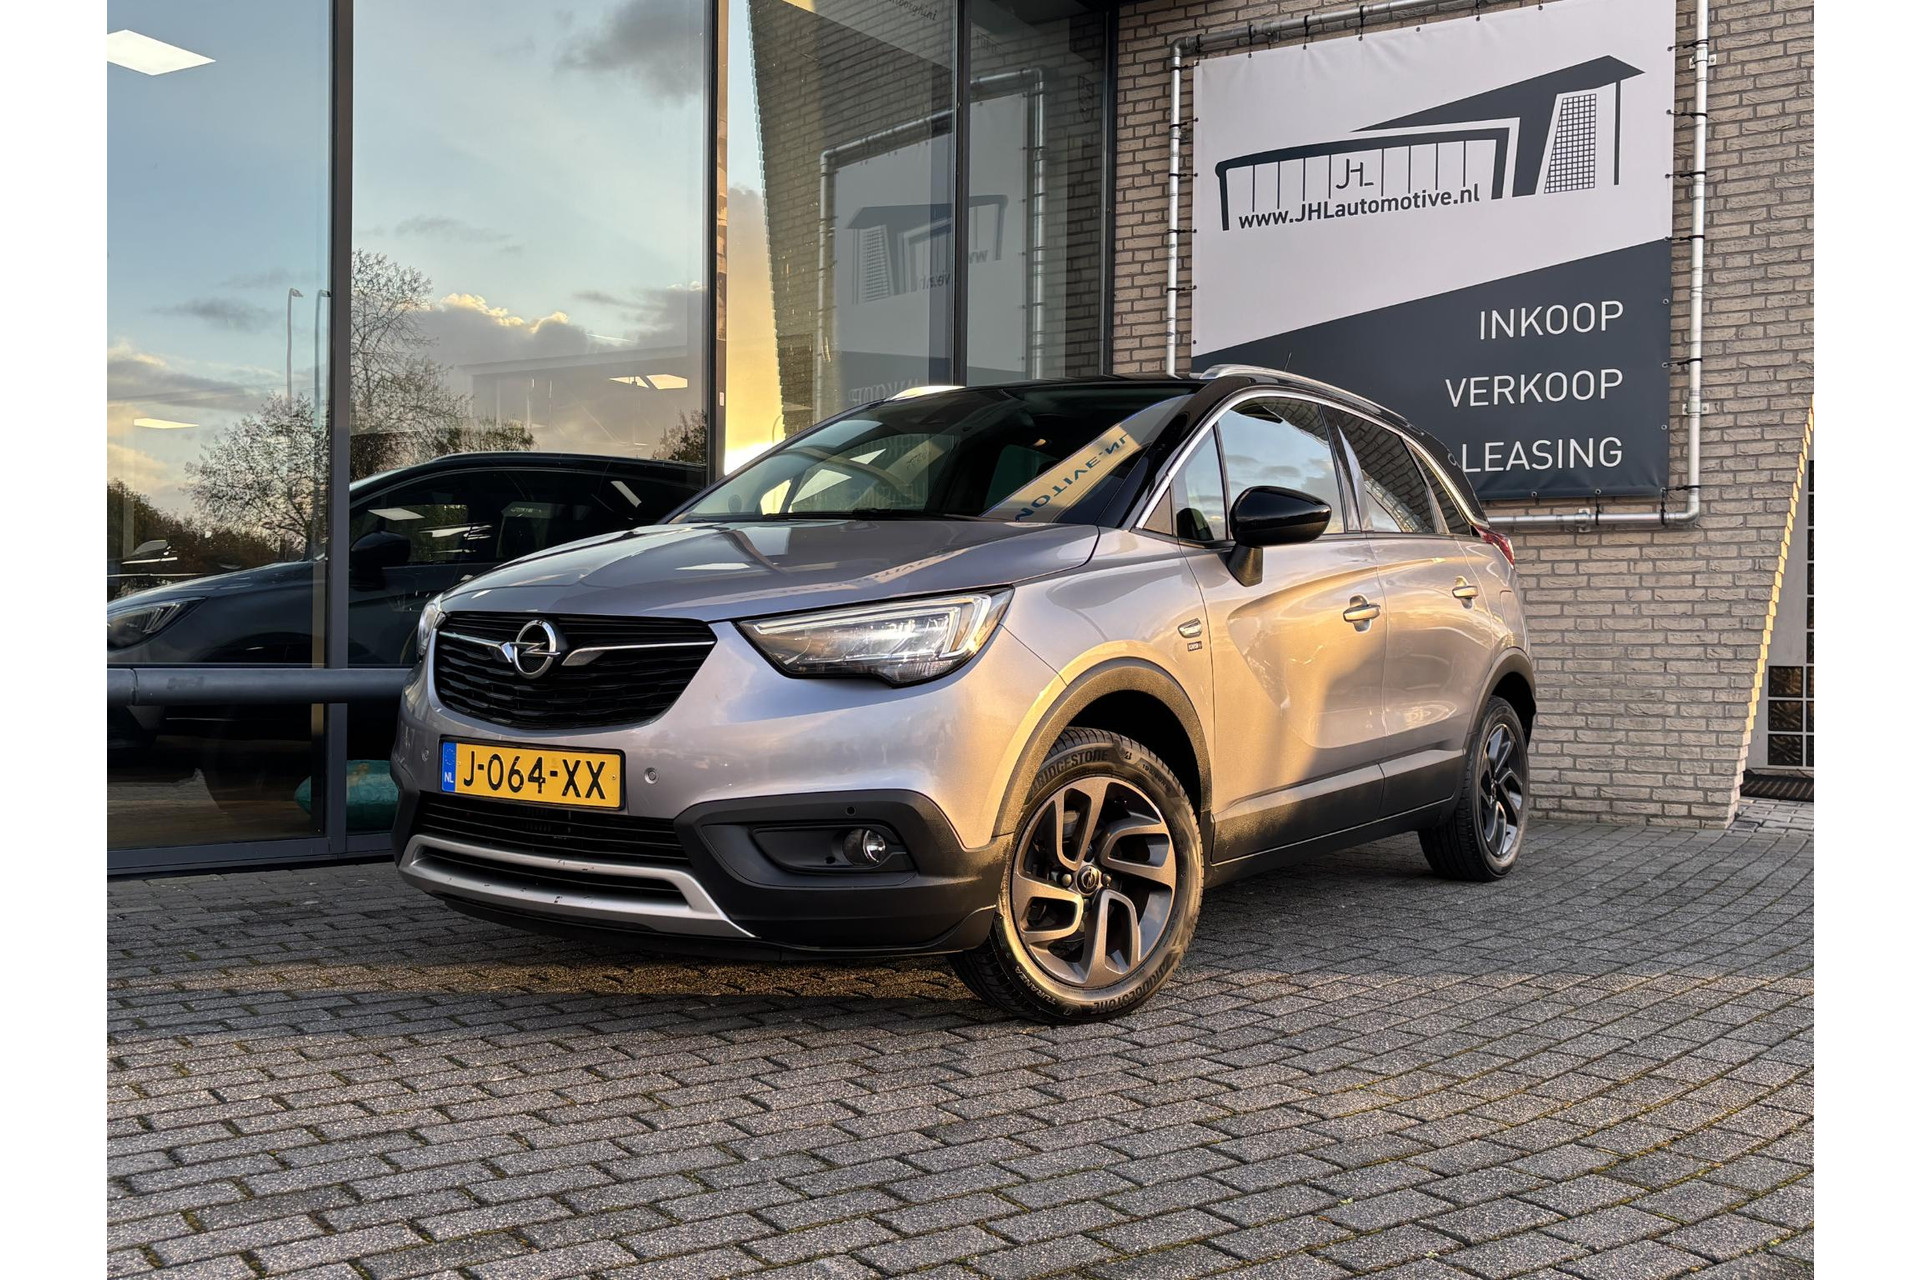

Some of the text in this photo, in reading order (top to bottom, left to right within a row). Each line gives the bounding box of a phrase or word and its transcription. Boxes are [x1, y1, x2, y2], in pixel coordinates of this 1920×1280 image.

[1336, 158, 1374, 189] JHL
[1239, 183, 1480, 229] www.JHLautomotive.nl
[1479, 301, 1624, 340] INKOOP
[1445, 369, 1624, 408] VERKOOP
[1462, 437, 1624, 473] LEASING
[444, 771, 454, 784] NL
[463, 751, 606, 800] J-064-XX
[1015, 965, 1056, 1005] TURANZA
